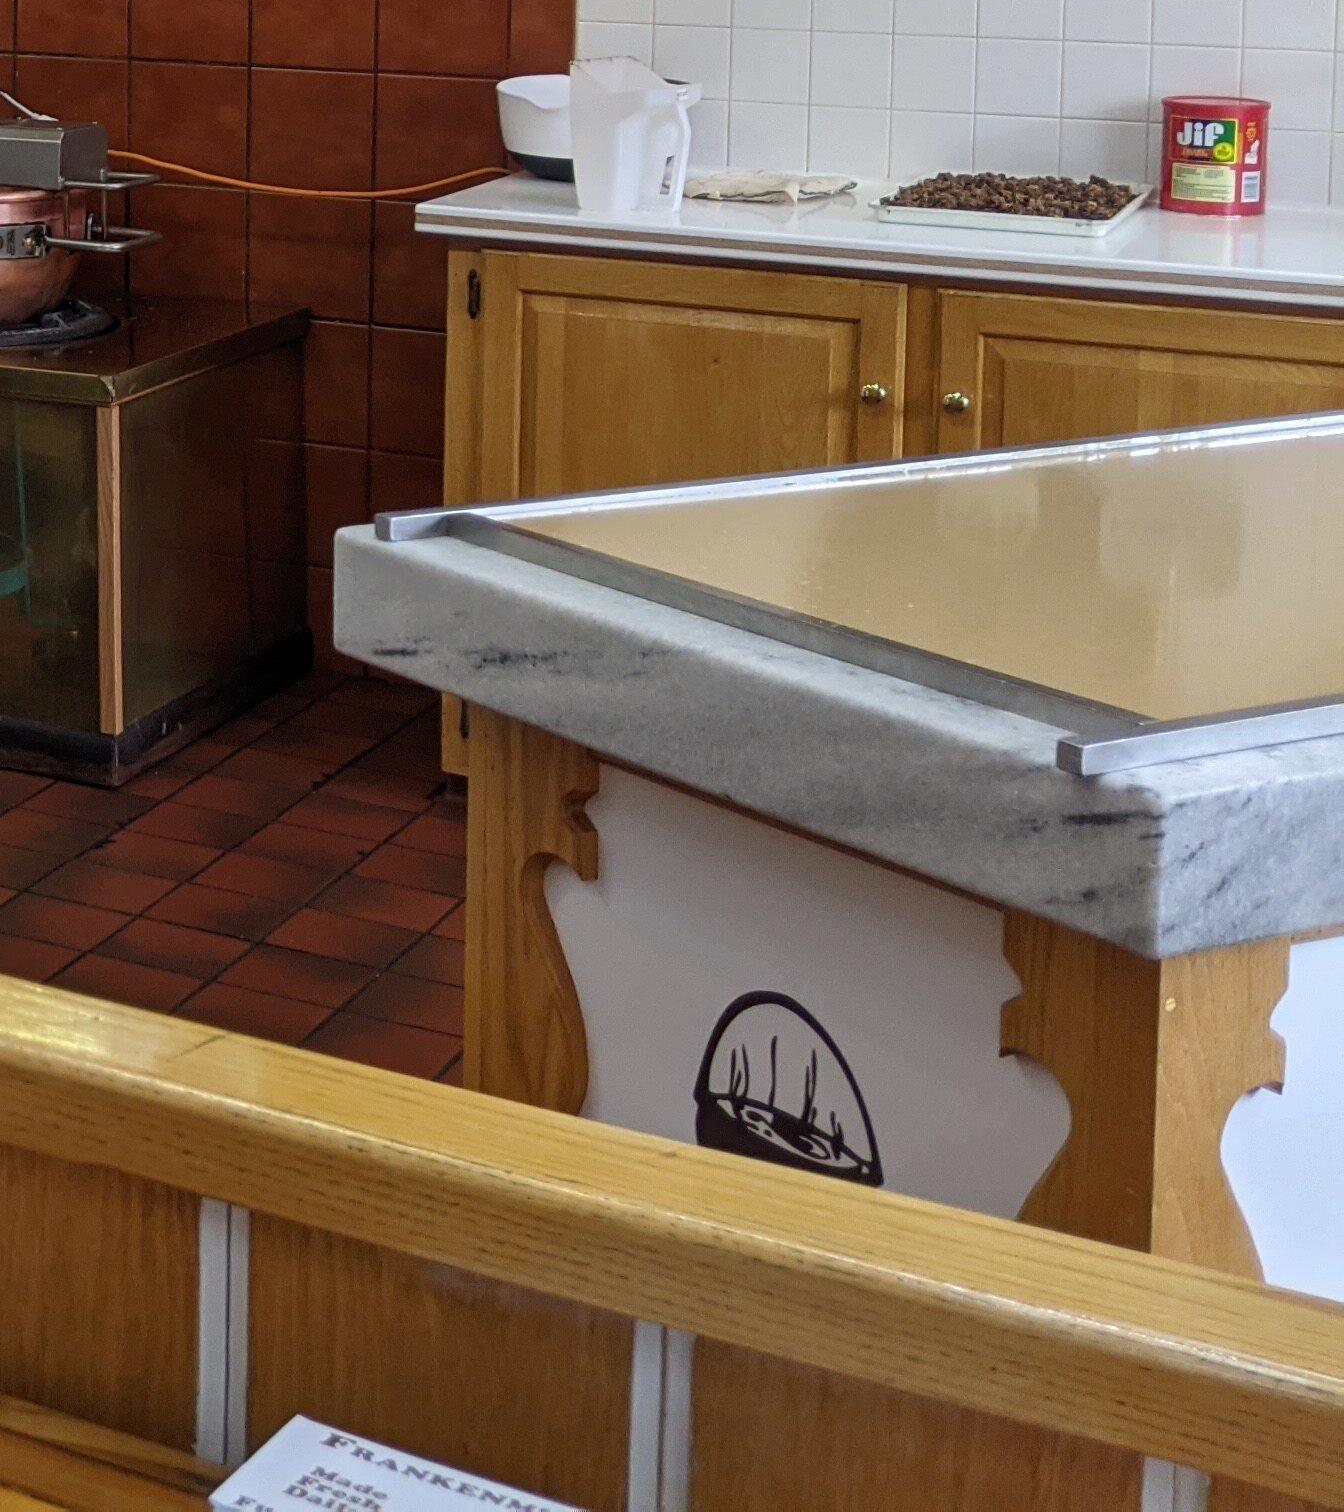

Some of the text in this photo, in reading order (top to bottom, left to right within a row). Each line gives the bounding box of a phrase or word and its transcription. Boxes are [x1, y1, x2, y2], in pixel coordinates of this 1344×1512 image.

[1177, 122, 1224, 147] Jif
[297, 1475, 383, 1510] Fresh
[310, 1466, 389, 1501] Made
